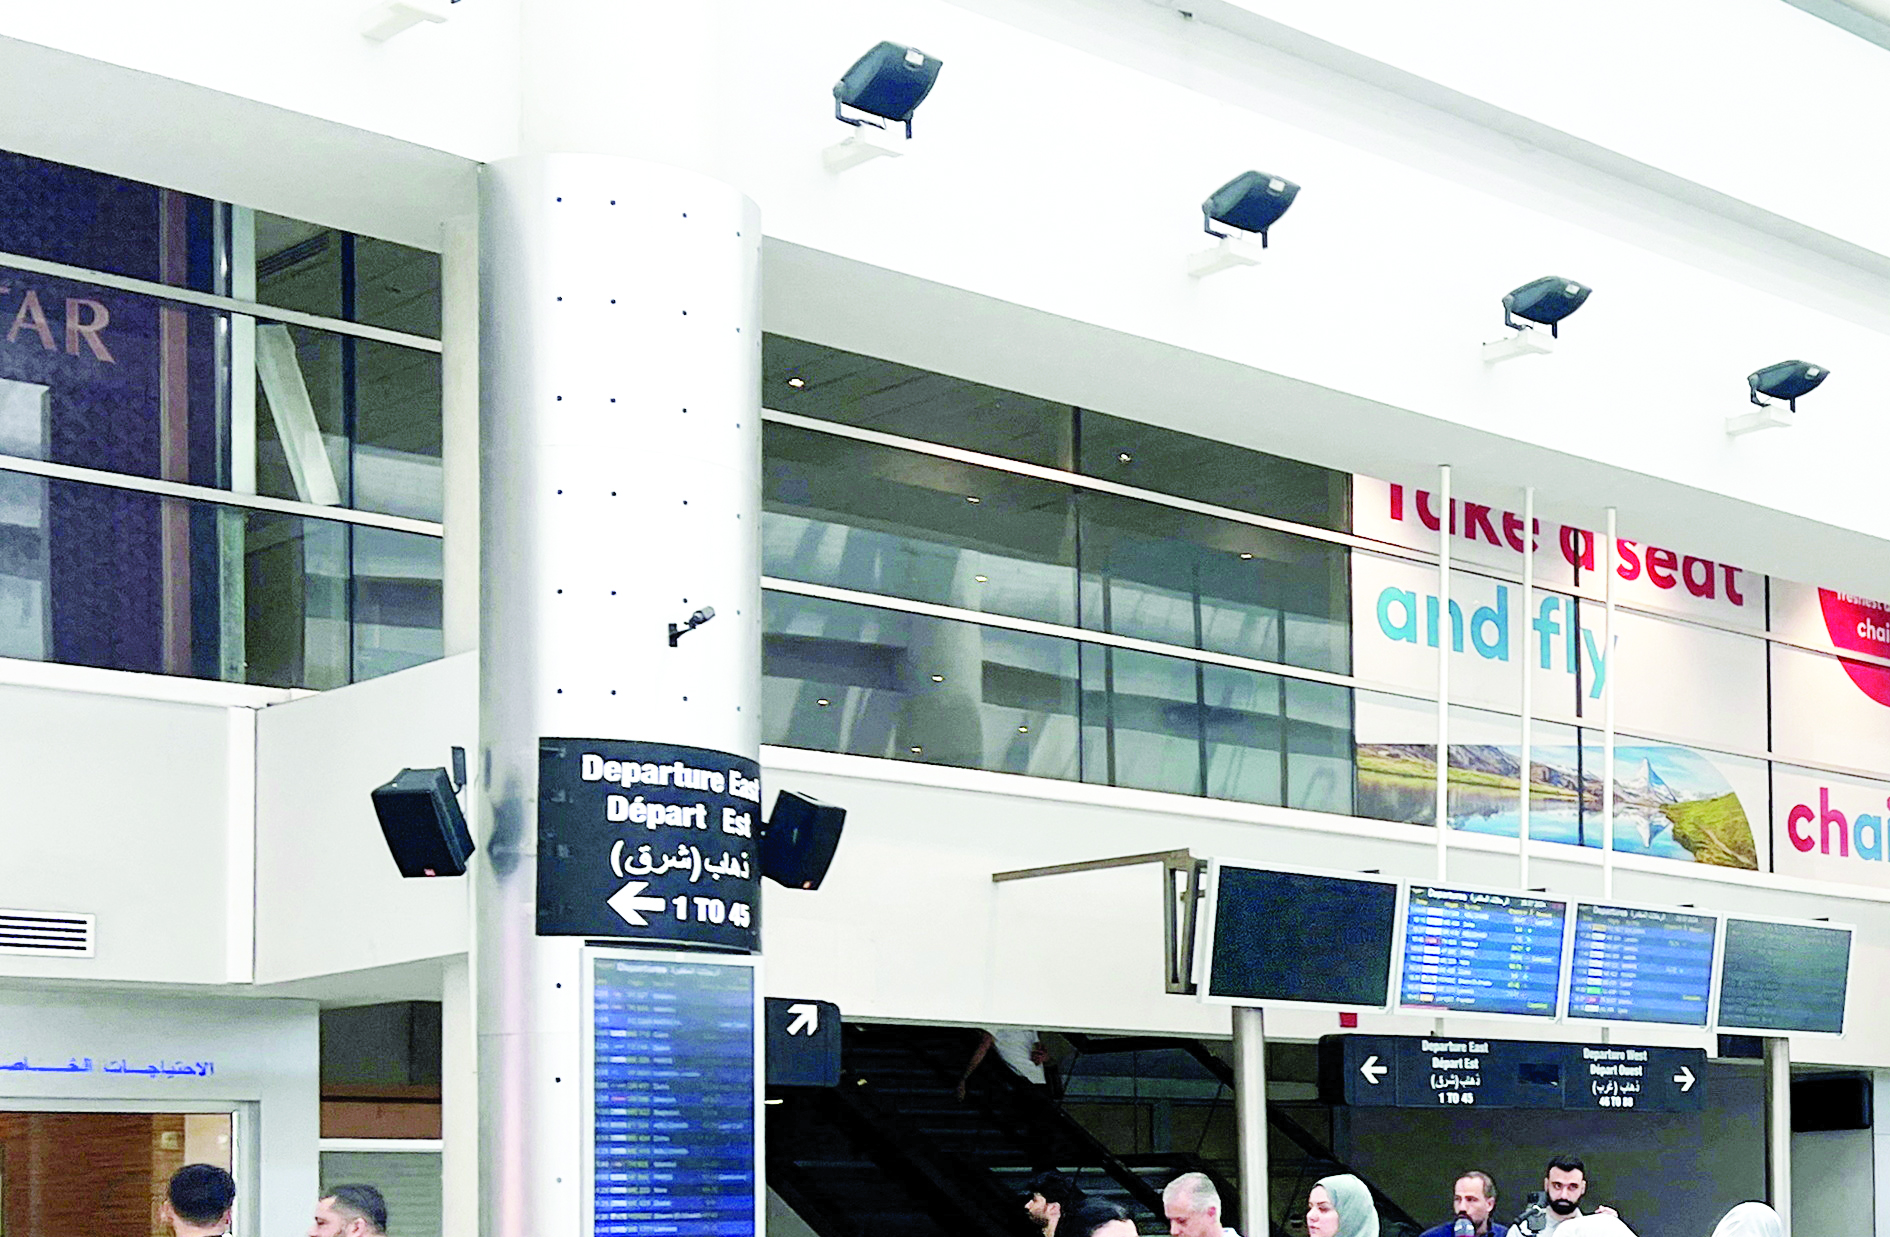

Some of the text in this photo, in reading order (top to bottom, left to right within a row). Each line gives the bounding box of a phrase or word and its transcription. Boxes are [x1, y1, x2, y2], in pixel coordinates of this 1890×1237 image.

[0, 286, 116, 365] AR
[1559, 524, 1594, 571] a
[1616, 537, 1743, 606] seat
[1376, 584, 1618, 700] and fly
[581, 753, 726, 793] Departure
[606, 794, 752, 838] Départ Est
[609, 839, 750, 883] ذهاب (شرق)
[671, 895, 751, 928] 1 TO 45
[1421, 1039, 1489, 1054] Departure East
[1431, 1057, 1480, 1071] Départ Est
[1582, 1047, 1648, 1062] Departure West
[1589, 1063, 1618, 1078] Départ
[1438, 1092, 1446, 1105] 1
[1446, 1092, 1460, 1105] TO
